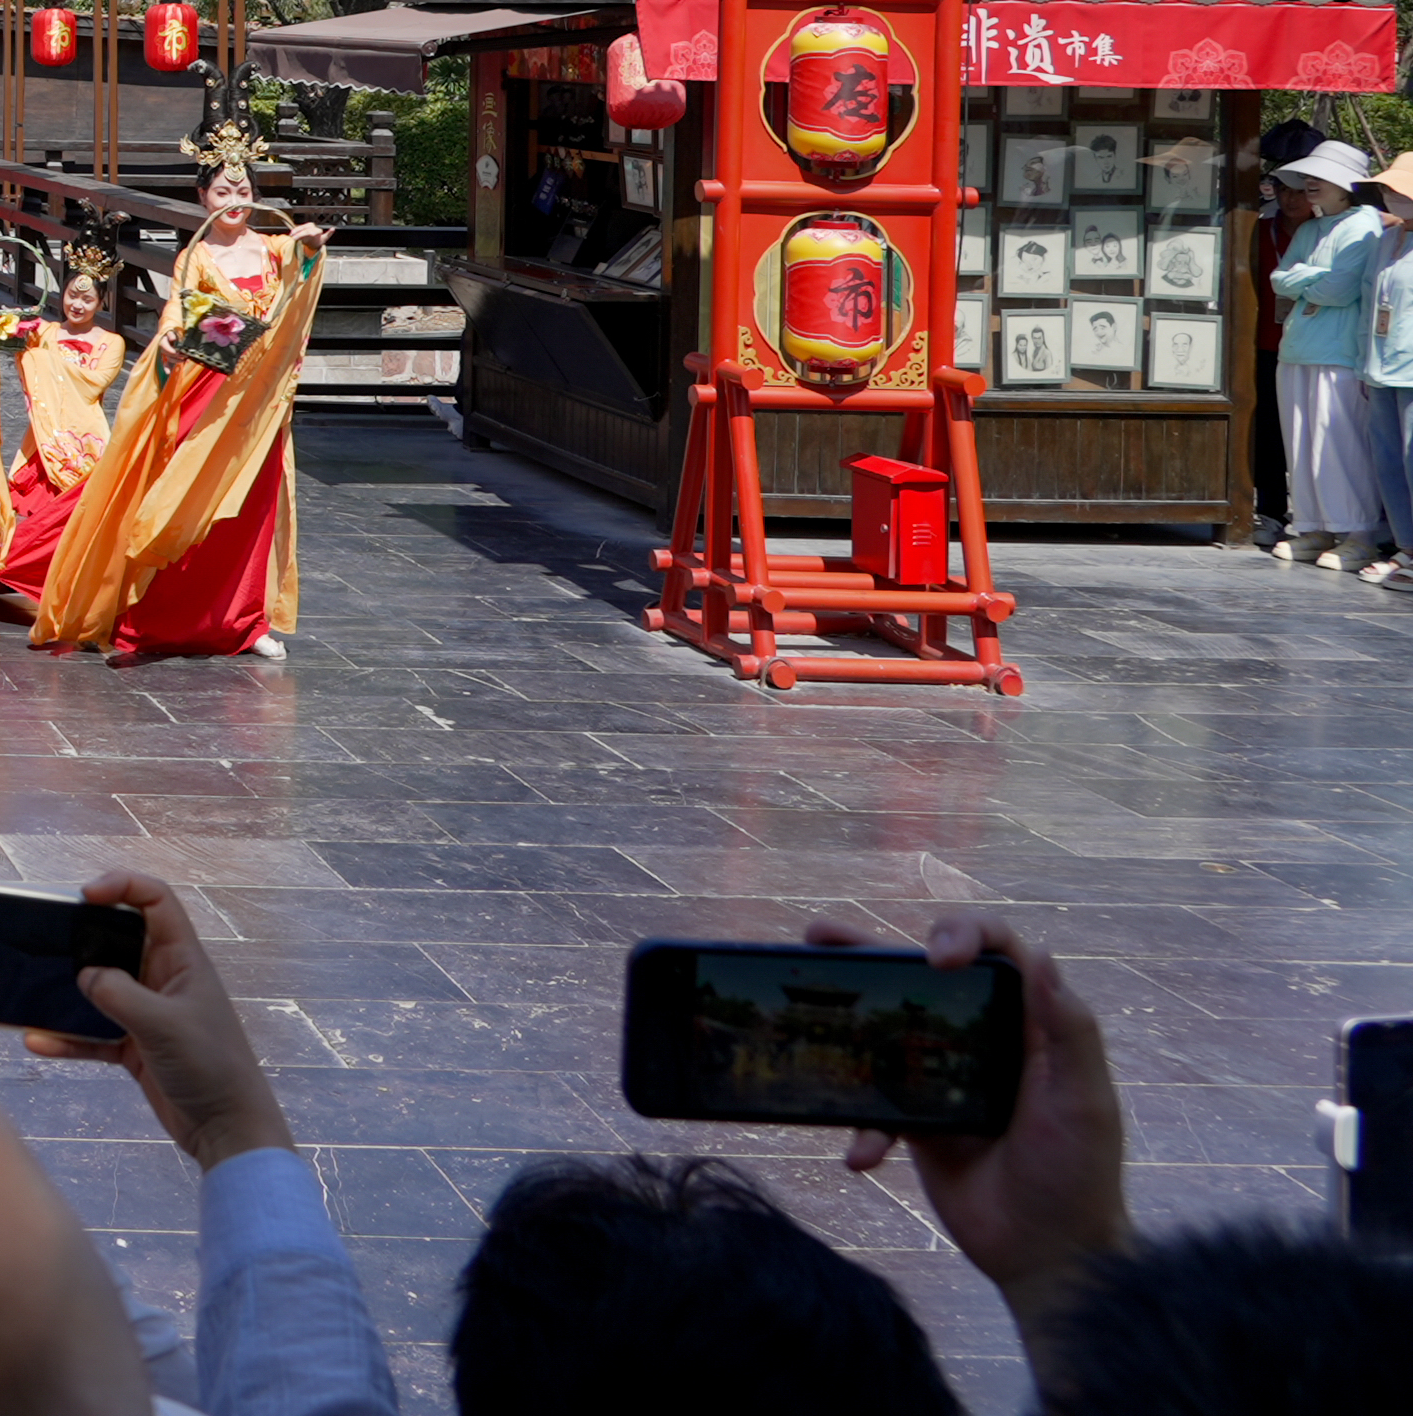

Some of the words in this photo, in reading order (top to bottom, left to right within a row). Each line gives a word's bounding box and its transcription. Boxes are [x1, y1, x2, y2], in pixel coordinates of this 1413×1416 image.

[961, 8, 1124, 85] 非遗市集
[828, 267, 876, 332] 市
